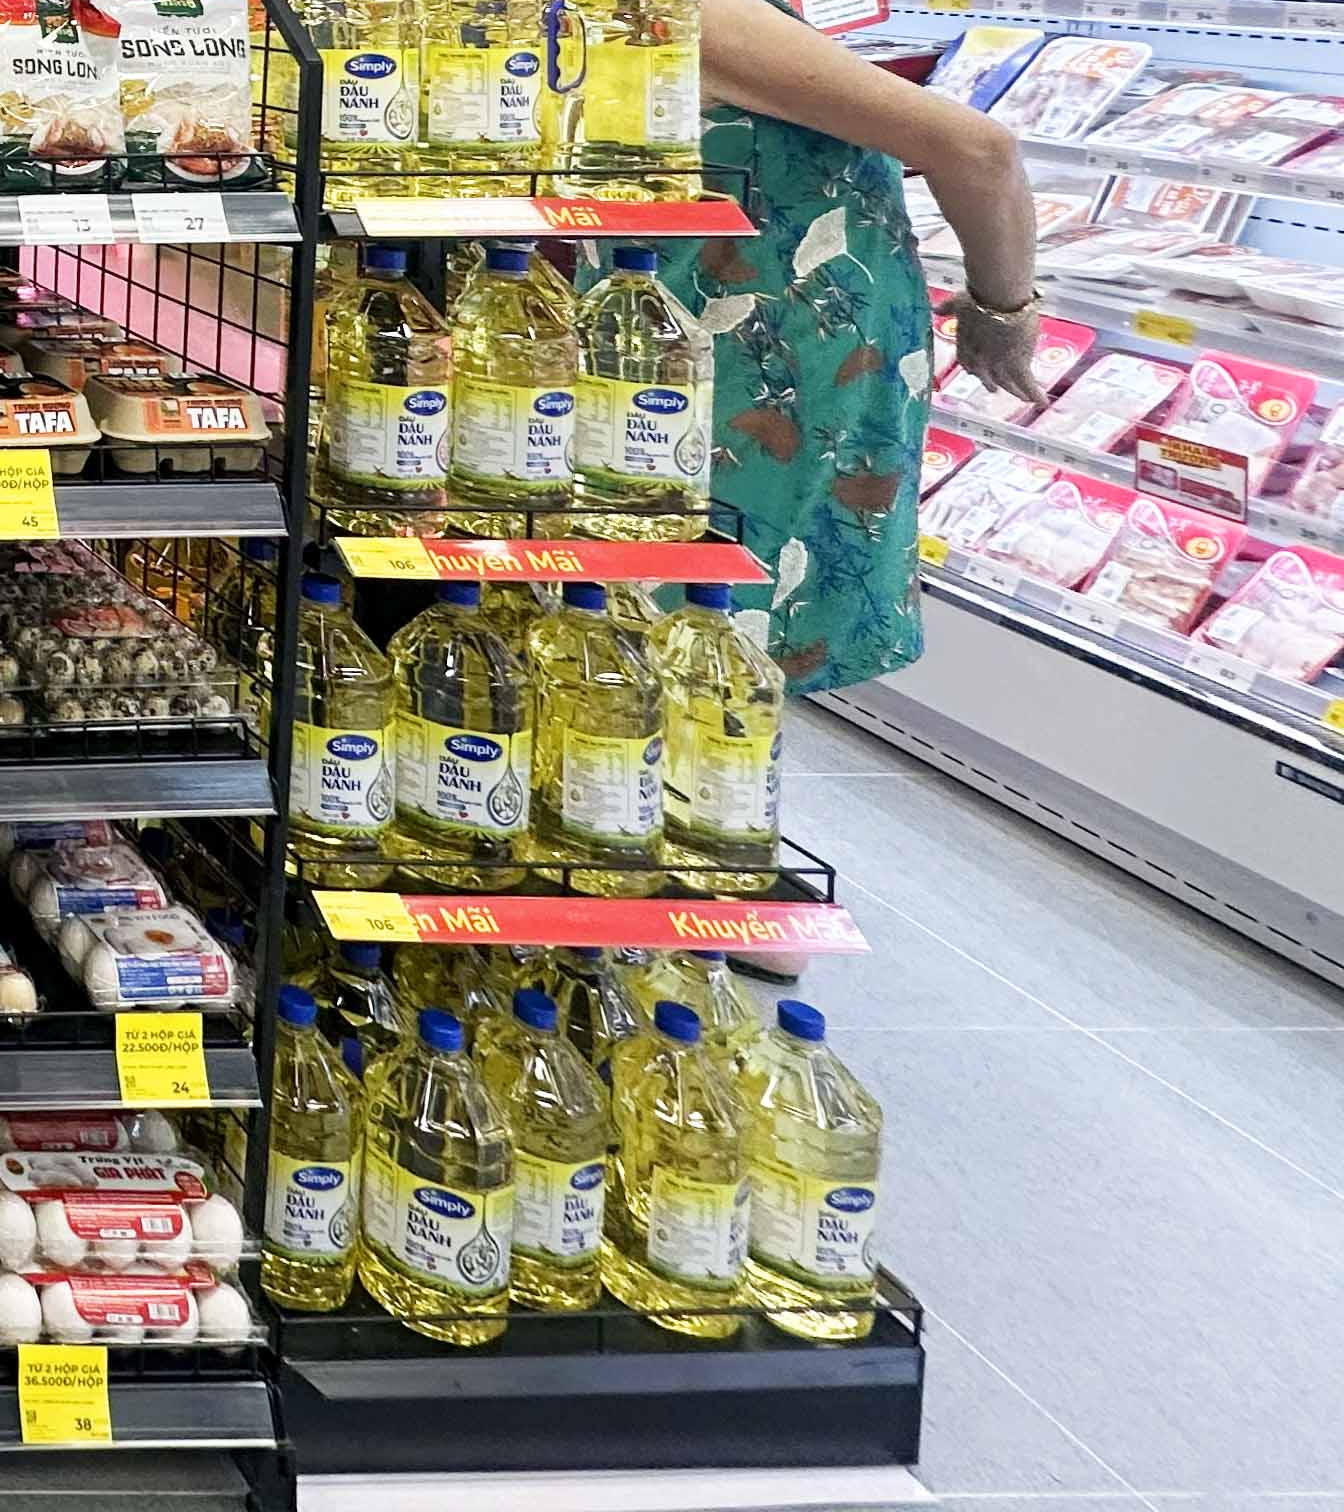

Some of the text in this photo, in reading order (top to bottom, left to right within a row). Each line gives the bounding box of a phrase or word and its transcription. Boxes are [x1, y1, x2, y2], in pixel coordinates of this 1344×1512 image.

[122, 39, 246, 59] SONG LONG
[184, 217, 204, 231] 27
[545, 204, 602, 227] Mãi
[14, 411, 74, 434] TAFA
[188, 406, 246, 431] TAFA
[22, 515, 39, 528] 45
[389, 560, 415, 571] 106
[432, 548, 584, 580] huyến Mãi
[668, 910, 787, 945] Khuyến
[171, 1082, 190, 1094] 24
[74, 1418, 92, 1431] 38
